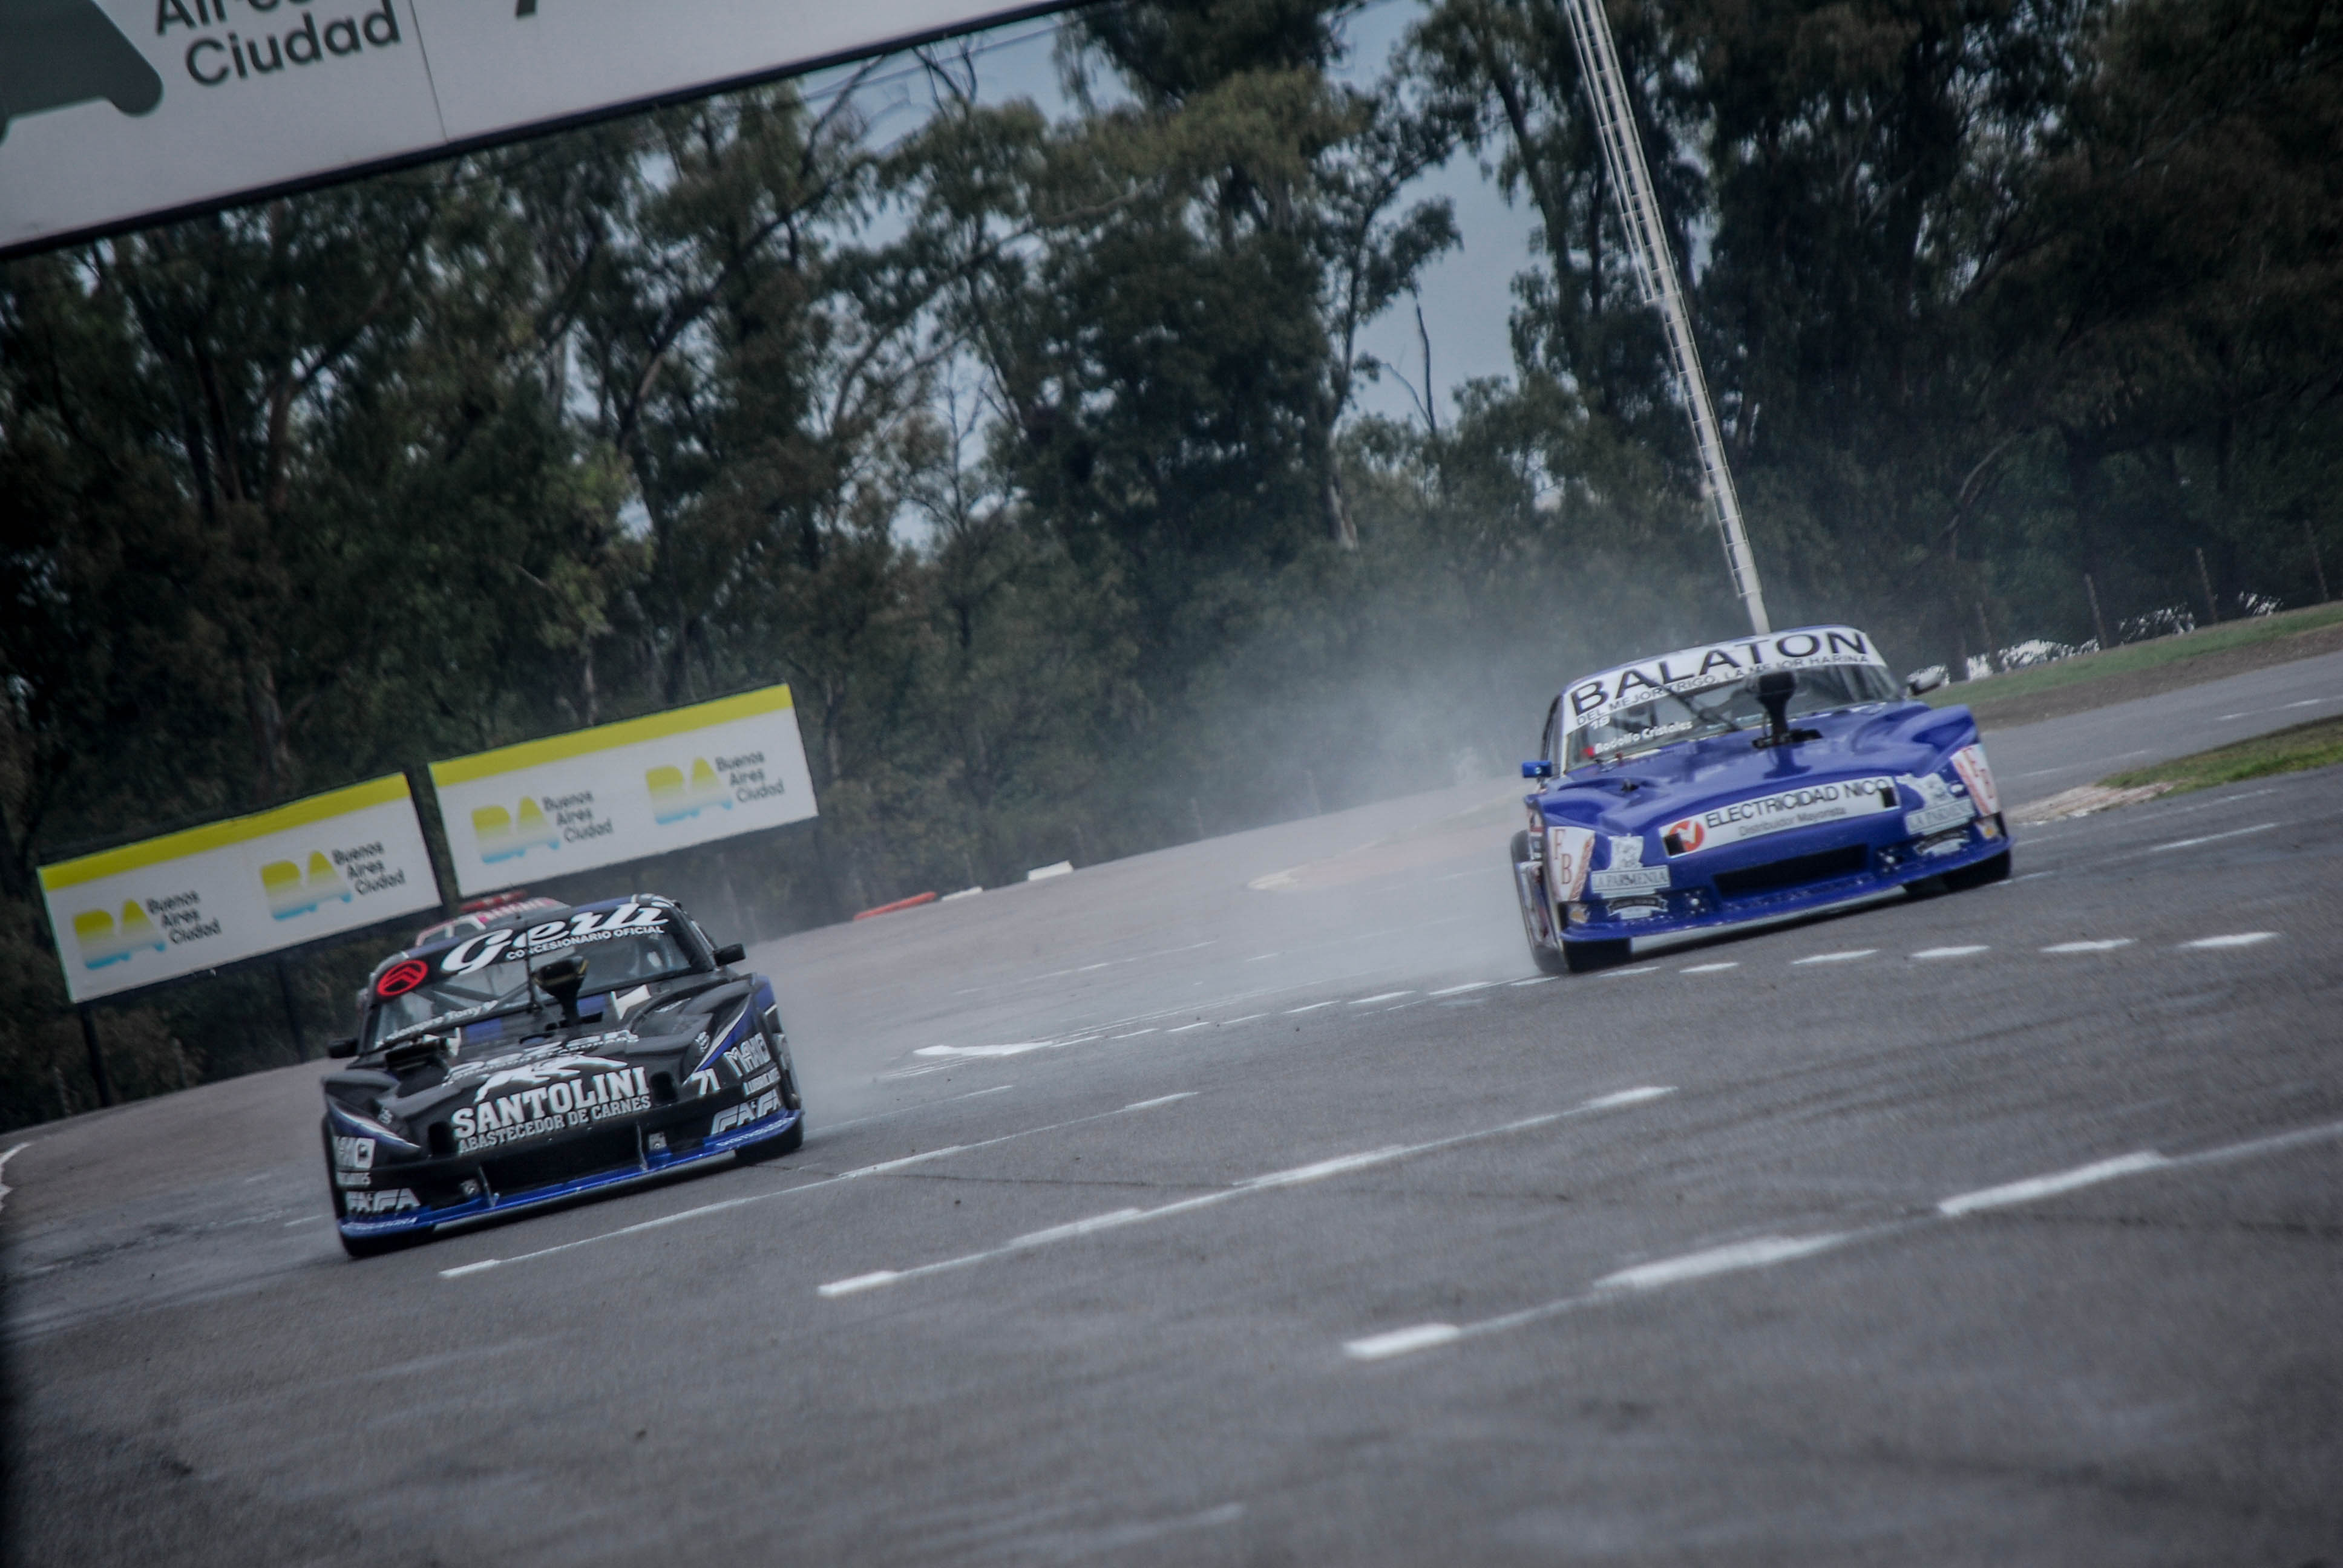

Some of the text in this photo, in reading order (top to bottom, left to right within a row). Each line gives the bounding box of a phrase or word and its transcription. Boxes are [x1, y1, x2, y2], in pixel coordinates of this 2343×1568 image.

[186, 0, 401, 85] Ciudad
[1571, 631, 1867, 717] BALATON
[1576, 709, 1607, 725] DEL
[1609, 687, 1663, 711] MEJOR
[1724, 667, 1746, 680] LA
[1809, 653, 1869, 666] HARINA
[715, 751, 765, 772] Buenos
[542, 791, 594, 812] Buenos
[1705, 786, 1839, 829] ELECTRICIDAD
[1738, 806, 1847, 837] Distribuidor Mayorista
[332, 841, 384, 866] Buenos
[146, 890, 202, 915] Buenos
[441, 903, 669, 975] Gerli
[614, 926, 665, 938] OFICIAL
[452, 1067, 650, 1139] SANTOLINI
[457, 1096, 652, 1156] ABASTECEDOR DE CARNES
